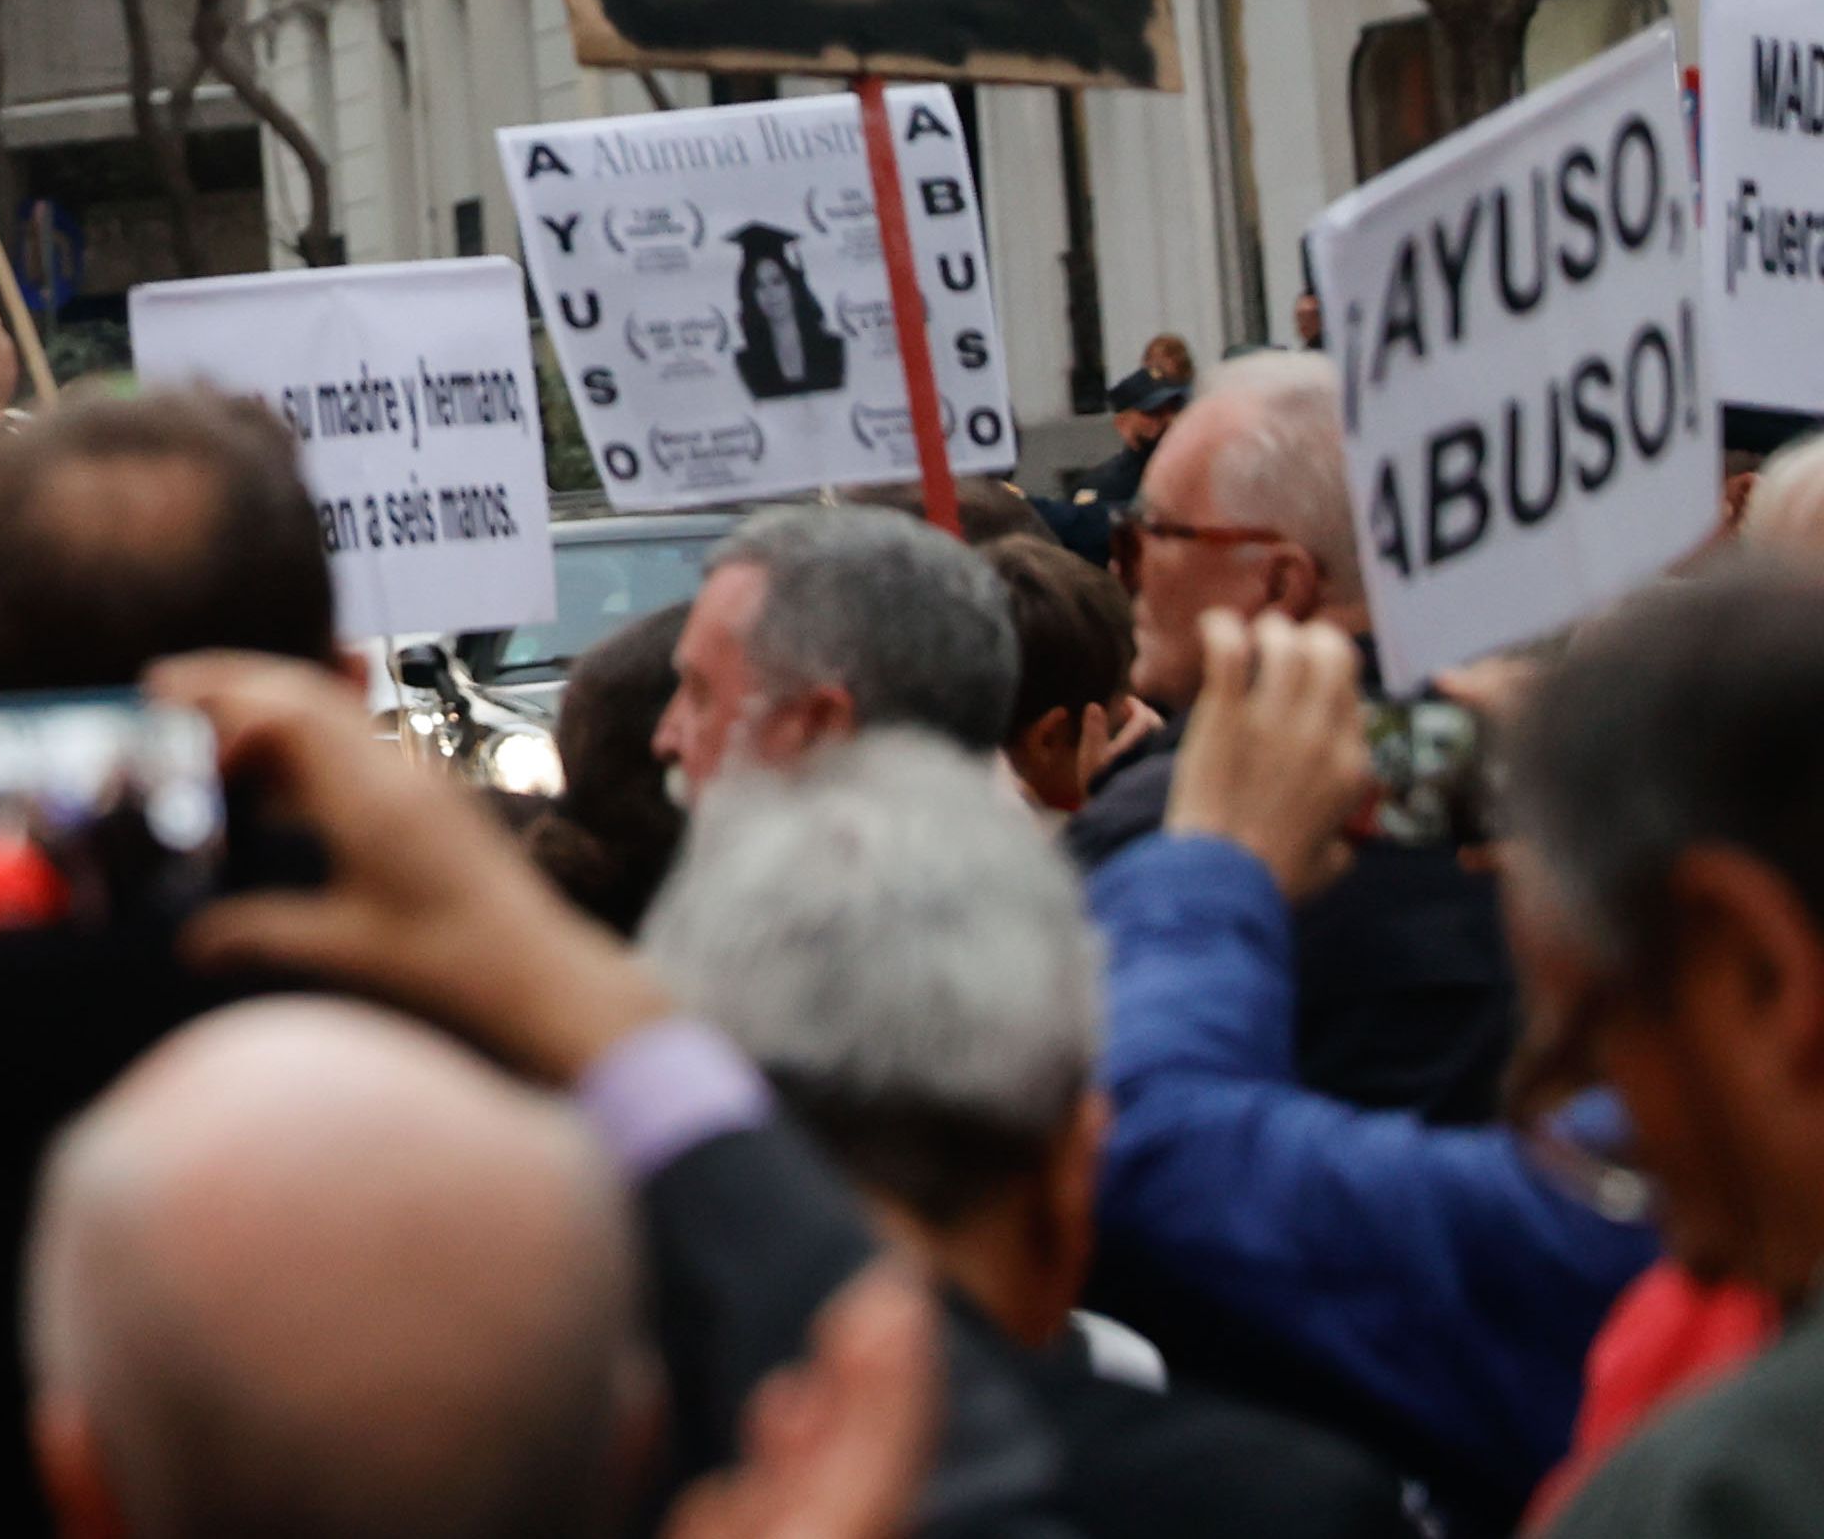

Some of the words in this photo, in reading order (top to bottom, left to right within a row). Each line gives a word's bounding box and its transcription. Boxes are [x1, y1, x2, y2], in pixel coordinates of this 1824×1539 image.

[1344, 113, 1684, 437] ¡AYUSO,
[317, 358, 400, 438] madre
[399, 375, 420, 449] y
[1370, 297, 1699, 580] ABUSO!
[364, 493, 383, 548] a
[385, 470, 437, 547] seis
[439, 482, 520, 541] manos.
